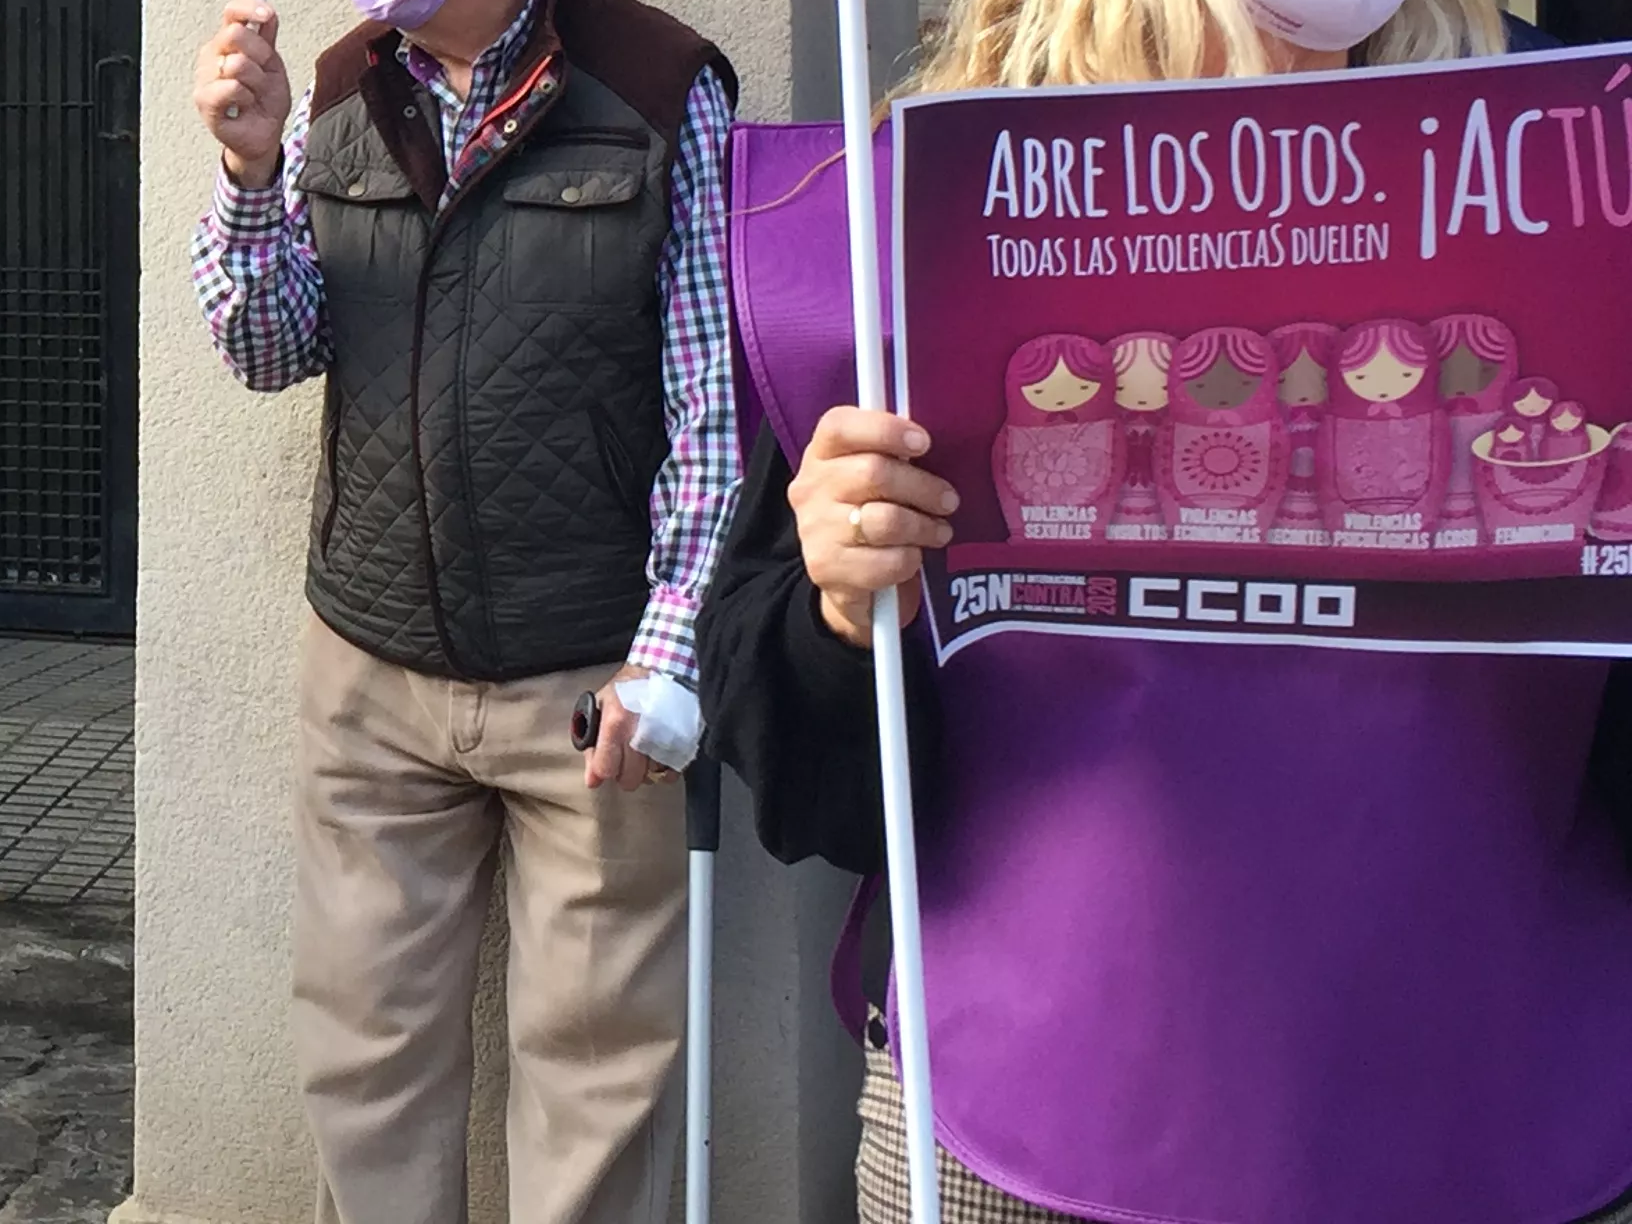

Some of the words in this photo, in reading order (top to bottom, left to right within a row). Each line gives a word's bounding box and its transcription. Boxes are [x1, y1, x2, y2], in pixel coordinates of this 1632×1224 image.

[983, 129, 1109, 219] ABRE
[1123, 123, 1214, 217] LOS
[1229, 116, 1387, 218] OJOS.
[987, 232, 1067, 278] TODAS
[1073, 234, 1118, 277] LAS
[1123, 223, 1286, 275] VIOLENCIAS
[1291, 222, 1390, 267] DUELEN
[1021, 506, 1098, 523] VIOLENCIAS
[1180, 507, 1257, 525] VIOLENCIAS
[1581, 544, 1632, 576] #25
[951, 573, 1011, 623] 25N
[1012, 584, 1086, 605] CONTRA
[1128, 577, 1356, 627] CCOO
